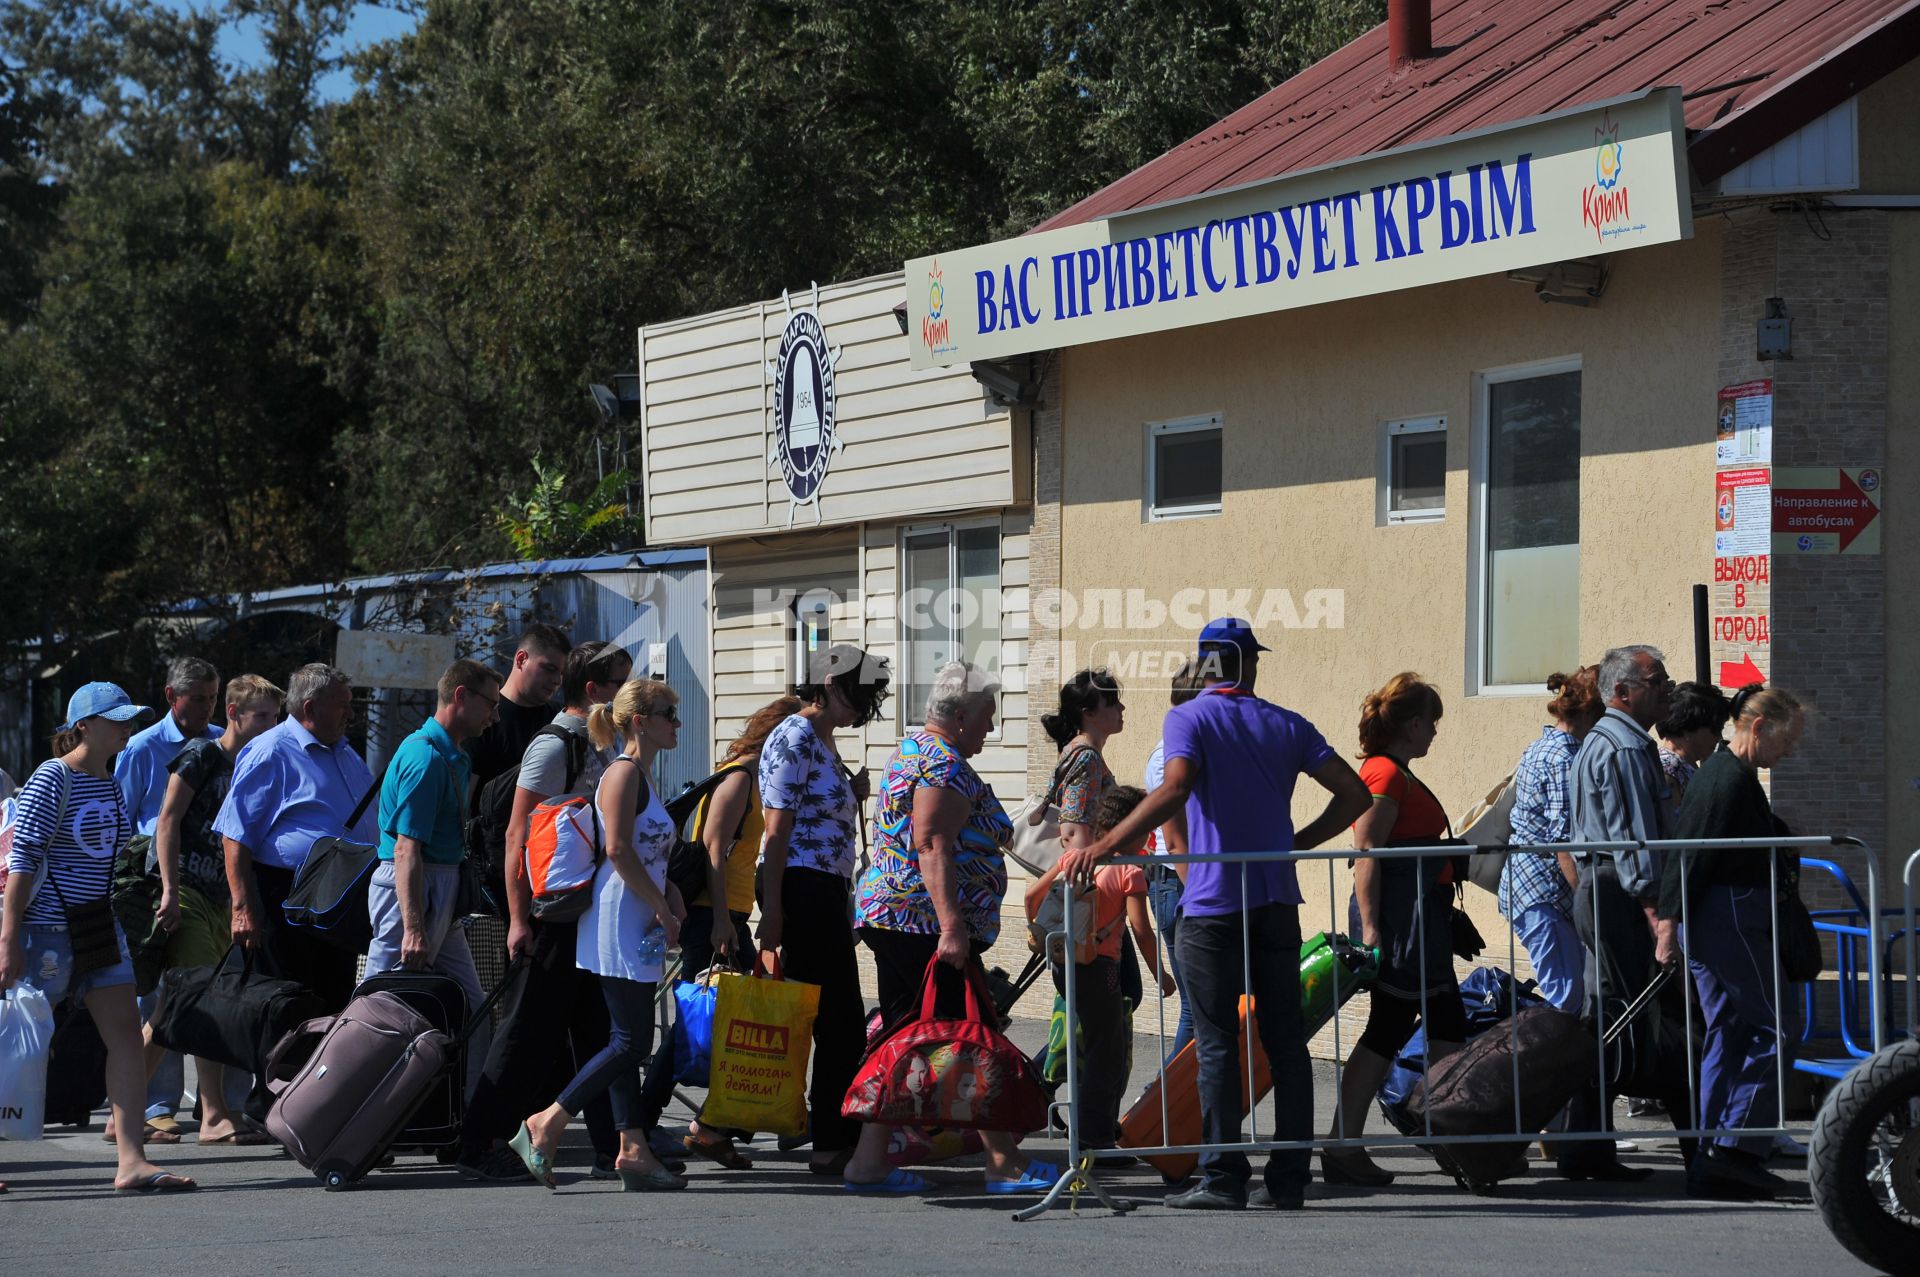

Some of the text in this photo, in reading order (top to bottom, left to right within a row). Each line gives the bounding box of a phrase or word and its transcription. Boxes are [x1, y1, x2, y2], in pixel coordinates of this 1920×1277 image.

[1582, 184, 1629, 245] Крым
[975, 153, 1537, 335] ВАС ПРИВЕТСТВУЕТ КРЫМ
[922, 314, 950, 360] Крым
[783, 314, 822, 355] ПАРОМНА
[812, 353, 833, 484] ПЕРЕПРАВА
[1774, 495, 1869, 509] Направление к
[1788, 514, 1854, 528] автобусам
[1715, 555, 1768, 584] ВЫХОД
[1735, 584, 1745, 608] В
[1715, 616, 1769, 645] ГОРОД
[730, 1024, 784, 1050] BILLA
[731, 1062, 792, 1080] помогаю
[0, 1106, 23, 1119] IN
